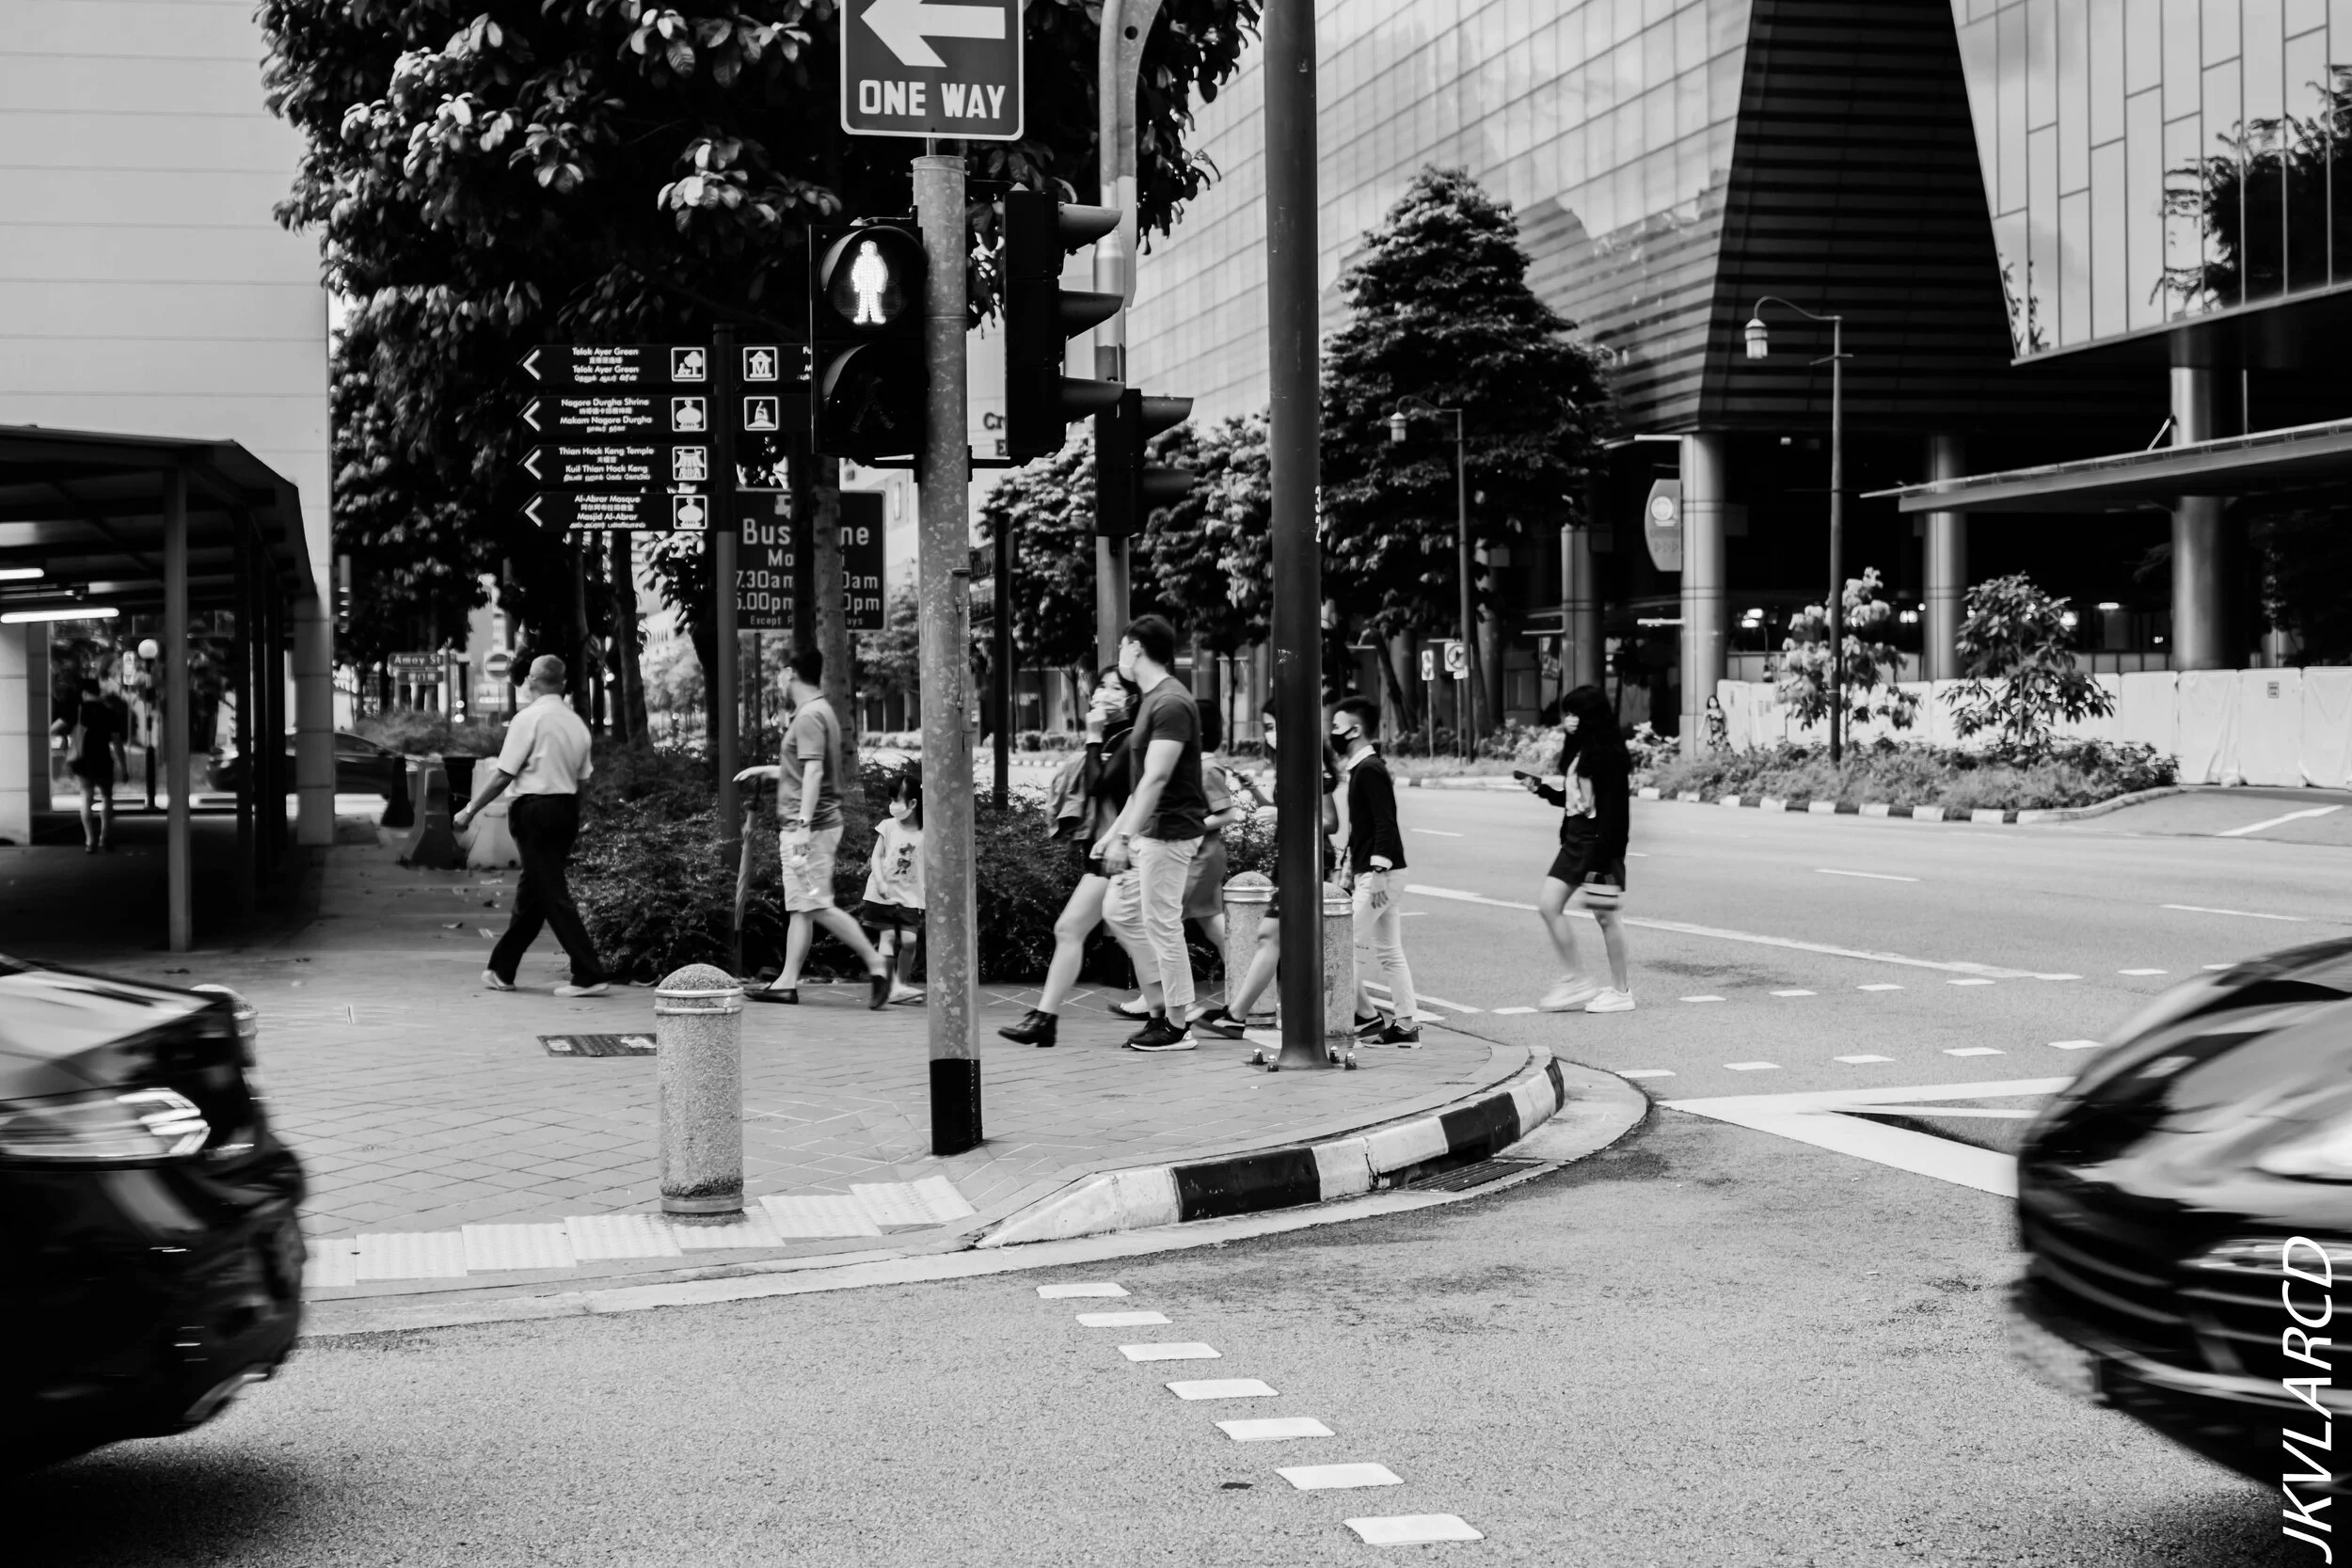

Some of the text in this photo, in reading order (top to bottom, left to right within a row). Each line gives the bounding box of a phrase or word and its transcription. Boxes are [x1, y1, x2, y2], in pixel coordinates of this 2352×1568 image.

[859, 79, 1006, 119] ONE WAY
[572, 346, 640, 357] Telok Ayer Green
[572, 364, 640, 374] Telok Ayer Green
[561, 398, 649, 408] Nagore Durgha Shrine
[560, 415, 653, 426] Makam Nagore Durgha
[559, 446, 655, 457] Thian Hock Keng Temple
[565, 465, 648, 474] Kuil Thian Hock Keng
[574, 495, 641, 504] Al-Abrar Mosque
[577, 513, 638, 522] Masjid Al-Abrar
[743, 518, 791, 546] Bus
[750, 615, 782, 627] Except
[395, 654, 440, 666] Amoy St
